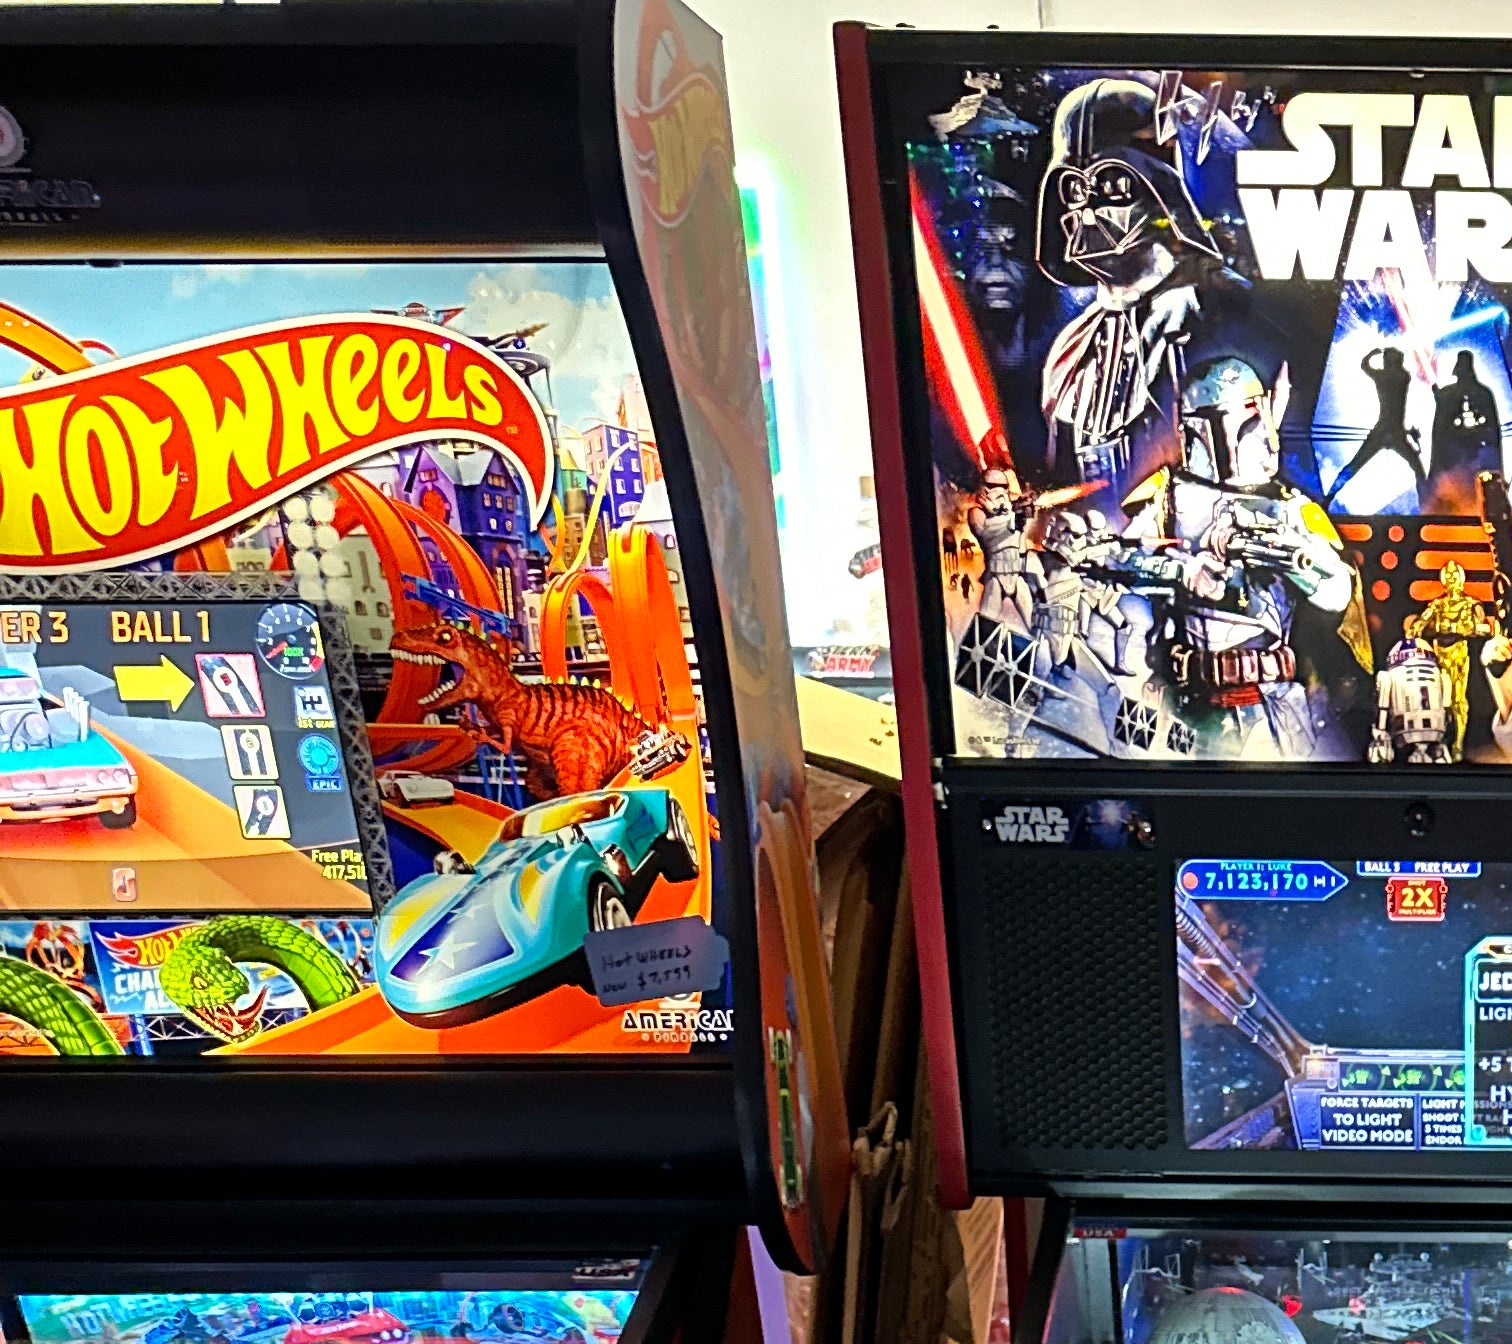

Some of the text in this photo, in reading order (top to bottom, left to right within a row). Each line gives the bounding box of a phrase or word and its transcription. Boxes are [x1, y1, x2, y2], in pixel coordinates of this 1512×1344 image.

[0, 332, 503, 557] HOT WHEELS
[50, 611, 69, 643] 3
[112, 611, 210, 643] BALL 1
[995, 806, 1069, 824] STAR
[996, 823, 1069, 843] WARS
[312, 849, 338, 863] Free
[1268, 863, 1292, 871] LUKE
[1364, 861, 1392, 872] BALL
[1414, 862, 1469, 873] FREE PLAY
[1205, 872, 1308, 891] 7,123,170
[1402, 887, 1434, 908] 2X
[602, 951, 633, 971] Hot
[1478, 1057, 1502, 1072] +5
[1321, 1097, 1414, 1109] FORCE TARGETS
[1422, 1099, 1458, 1109] LIGHT
[1333, 1113, 1402, 1126] TO LIGHT
[1422, 1113, 1459, 1122] SHOOT
[1433, 1124, 1462, 1134] TIMES
[1322, 1130, 1413, 1142] VIDEO MODE
[1425, 1135, 1461, 1145] ENDOR
